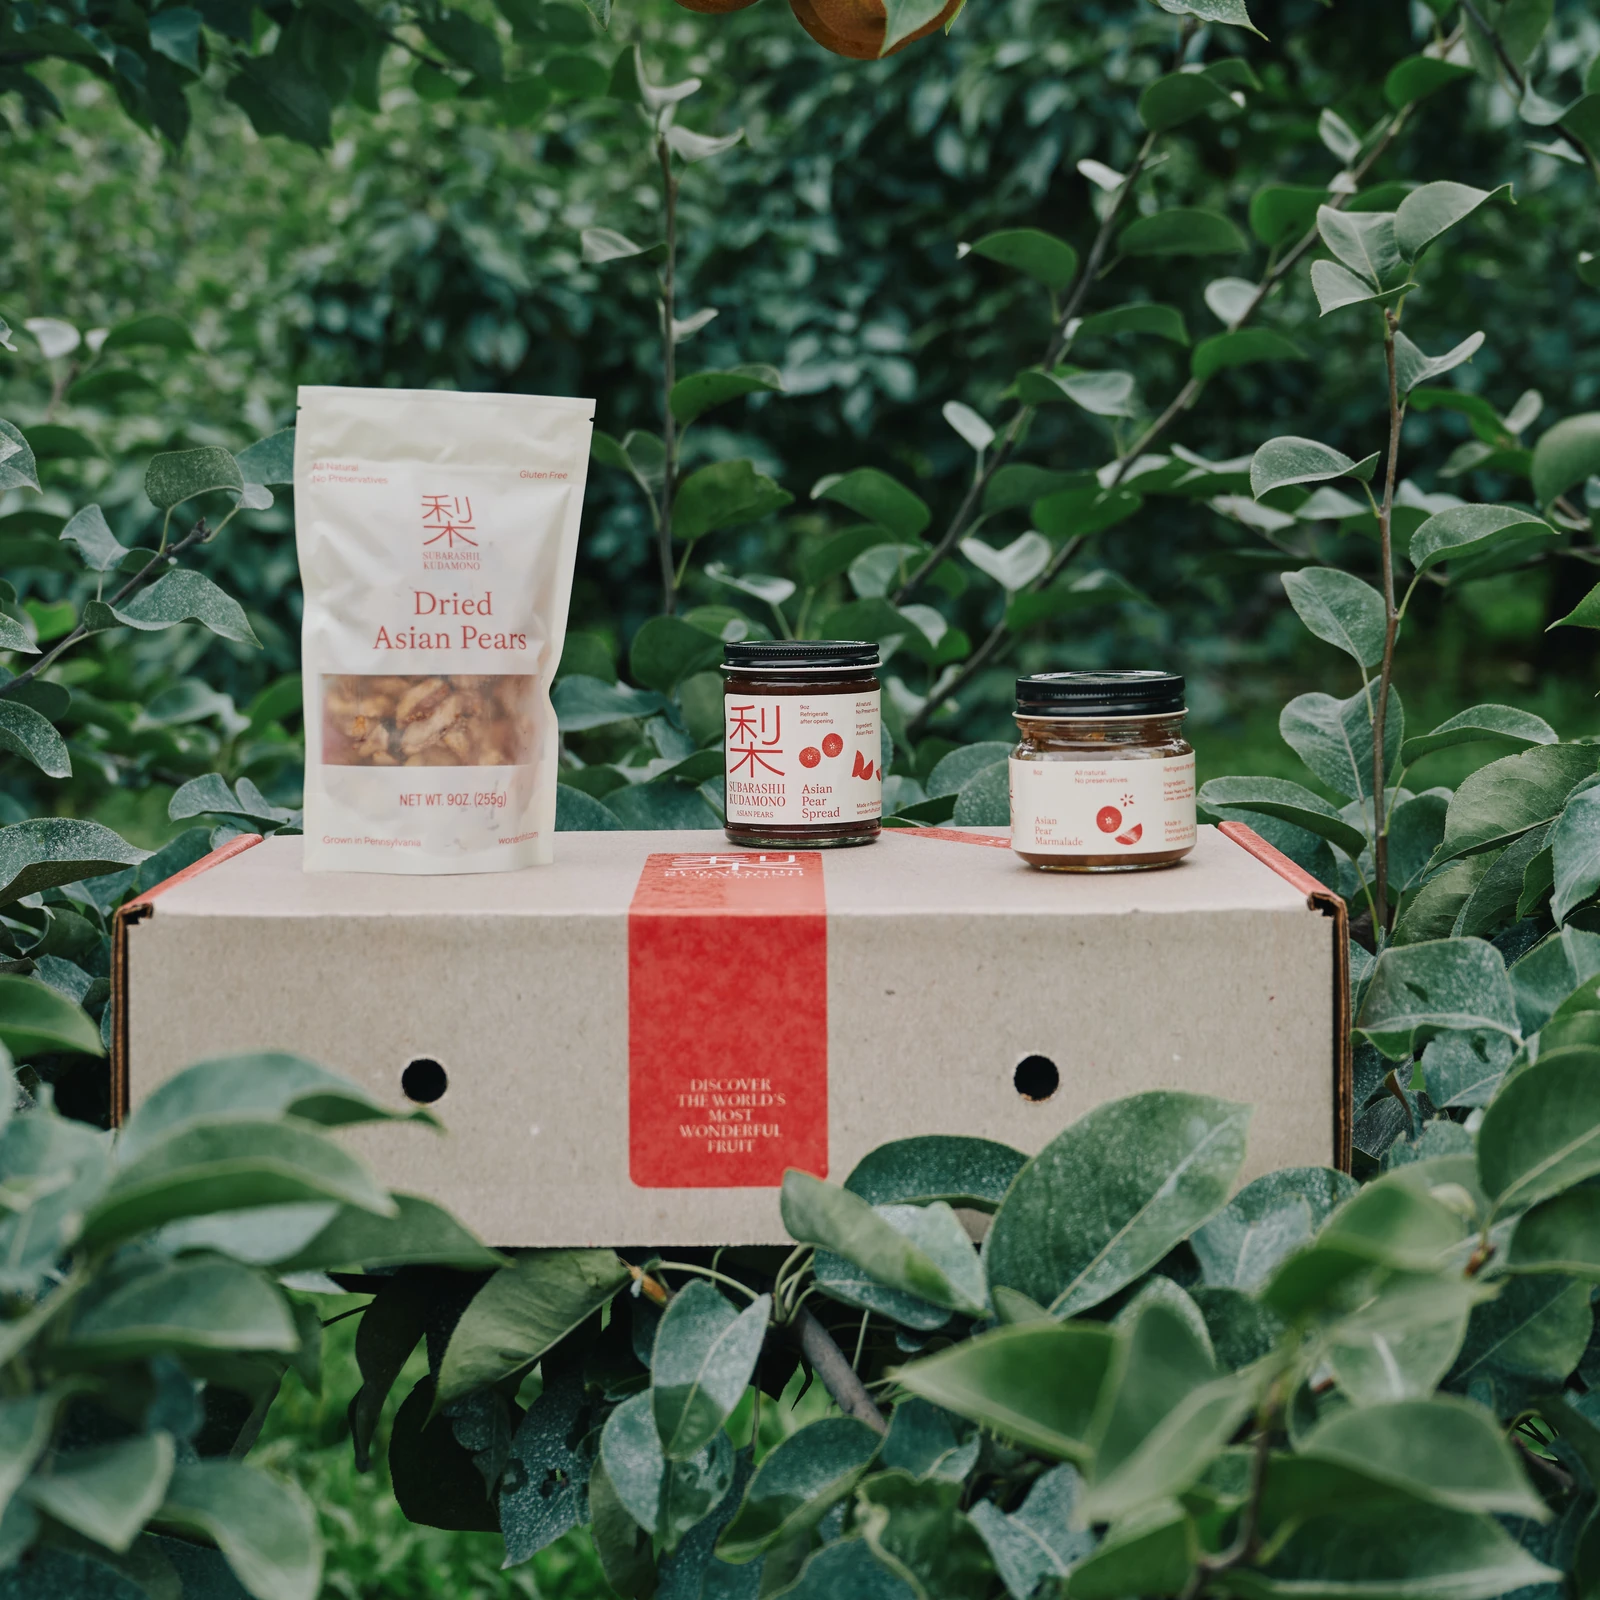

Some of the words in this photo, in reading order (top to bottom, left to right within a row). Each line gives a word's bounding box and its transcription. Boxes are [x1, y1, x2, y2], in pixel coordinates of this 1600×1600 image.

[326, 463, 359, 472] Natural
[313, 475, 326, 483] No
[328, 474, 388, 484] Preservatives
[519, 470, 547, 480] Gluten
[549, 471, 568, 480] Free
[422, 494, 479, 548] 梨
[423, 561, 481, 571] KUDAMONO
[414, 590, 493, 616] Dried
[373, 625, 451, 650] Asian
[460, 625, 528, 650] Pears
[729, 704, 786, 778] 梨
[729, 782, 786, 795] SUBARASHII
[801, 783, 833, 794] Asian
[400, 793, 422, 806] NET
[425, 793, 443, 806] WT.
[474, 791, 507, 808] (255g)
[729, 795, 786, 807] KUDAMONO
[801, 796, 827, 806] Pear
[736, 809, 753, 818] ASIAN
[753, 810, 774, 818] PEARS
[801, 807, 841, 821] Spread
[1035, 816, 1057, 825] Asian
[1035, 826, 1053, 835] Pear
[322, 835, 352, 846] Grown
[354, 836, 362, 845] in
[364, 837, 421, 848] Pennsylvania
[1035, 836, 1084, 846] Marmalade
[690, 1078, 772, 1092] DISCOVER
[677, 1094, 709, 1107] THE
[711, 1093, 787, 1107] WORLD'S
[708, 1109, 753, 1122] MOST
[679, 1124, 782, 1138] WONDERFUL
[707, 1139, 756, 1153] FRUIT
